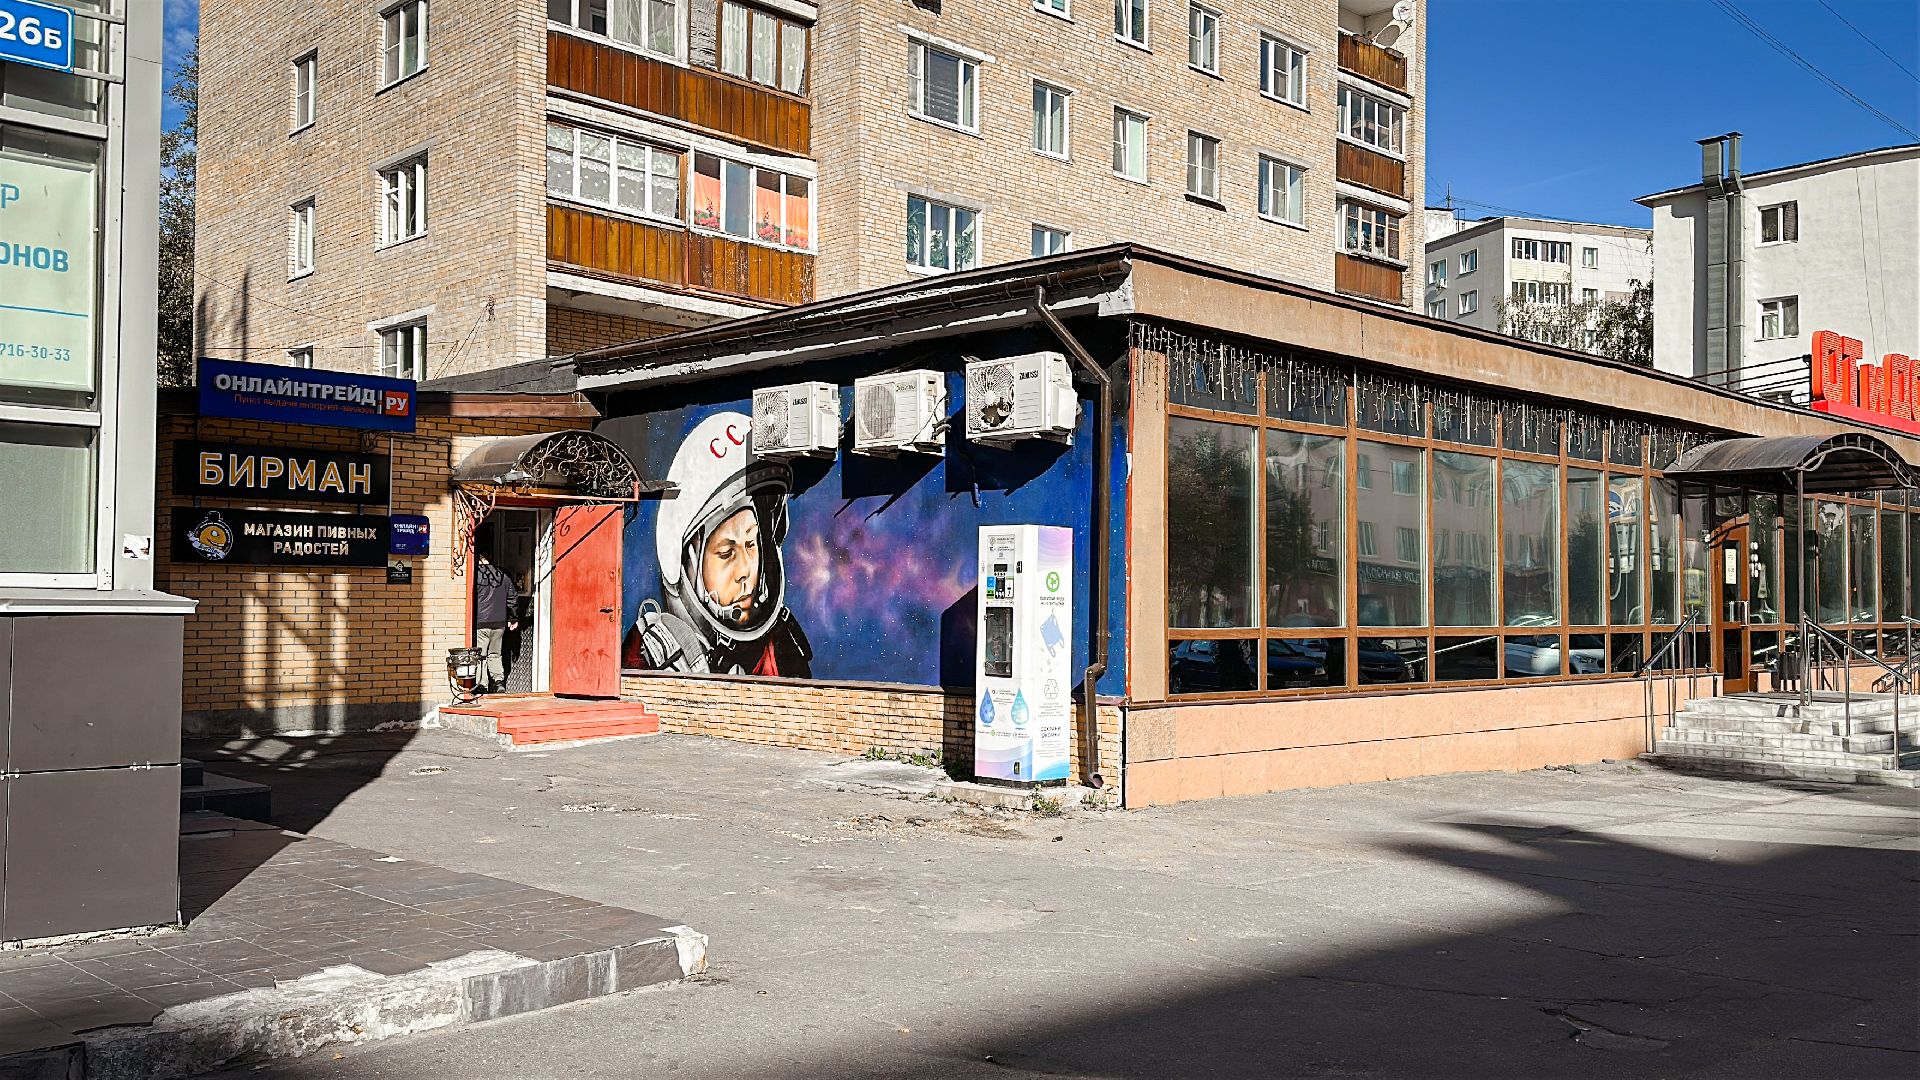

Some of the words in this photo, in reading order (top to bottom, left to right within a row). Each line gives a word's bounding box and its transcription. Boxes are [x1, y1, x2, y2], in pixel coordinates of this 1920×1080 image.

[0, 11, 62, 49] 26Б
[200, 452, 371, 494] БИРМАН
[244, 523, 313, 538] МАГАЗИН
[317, 526, 377, 540] ПИВНЫХ
[273, 541, 349, 556] РАДОСТЕЙ
